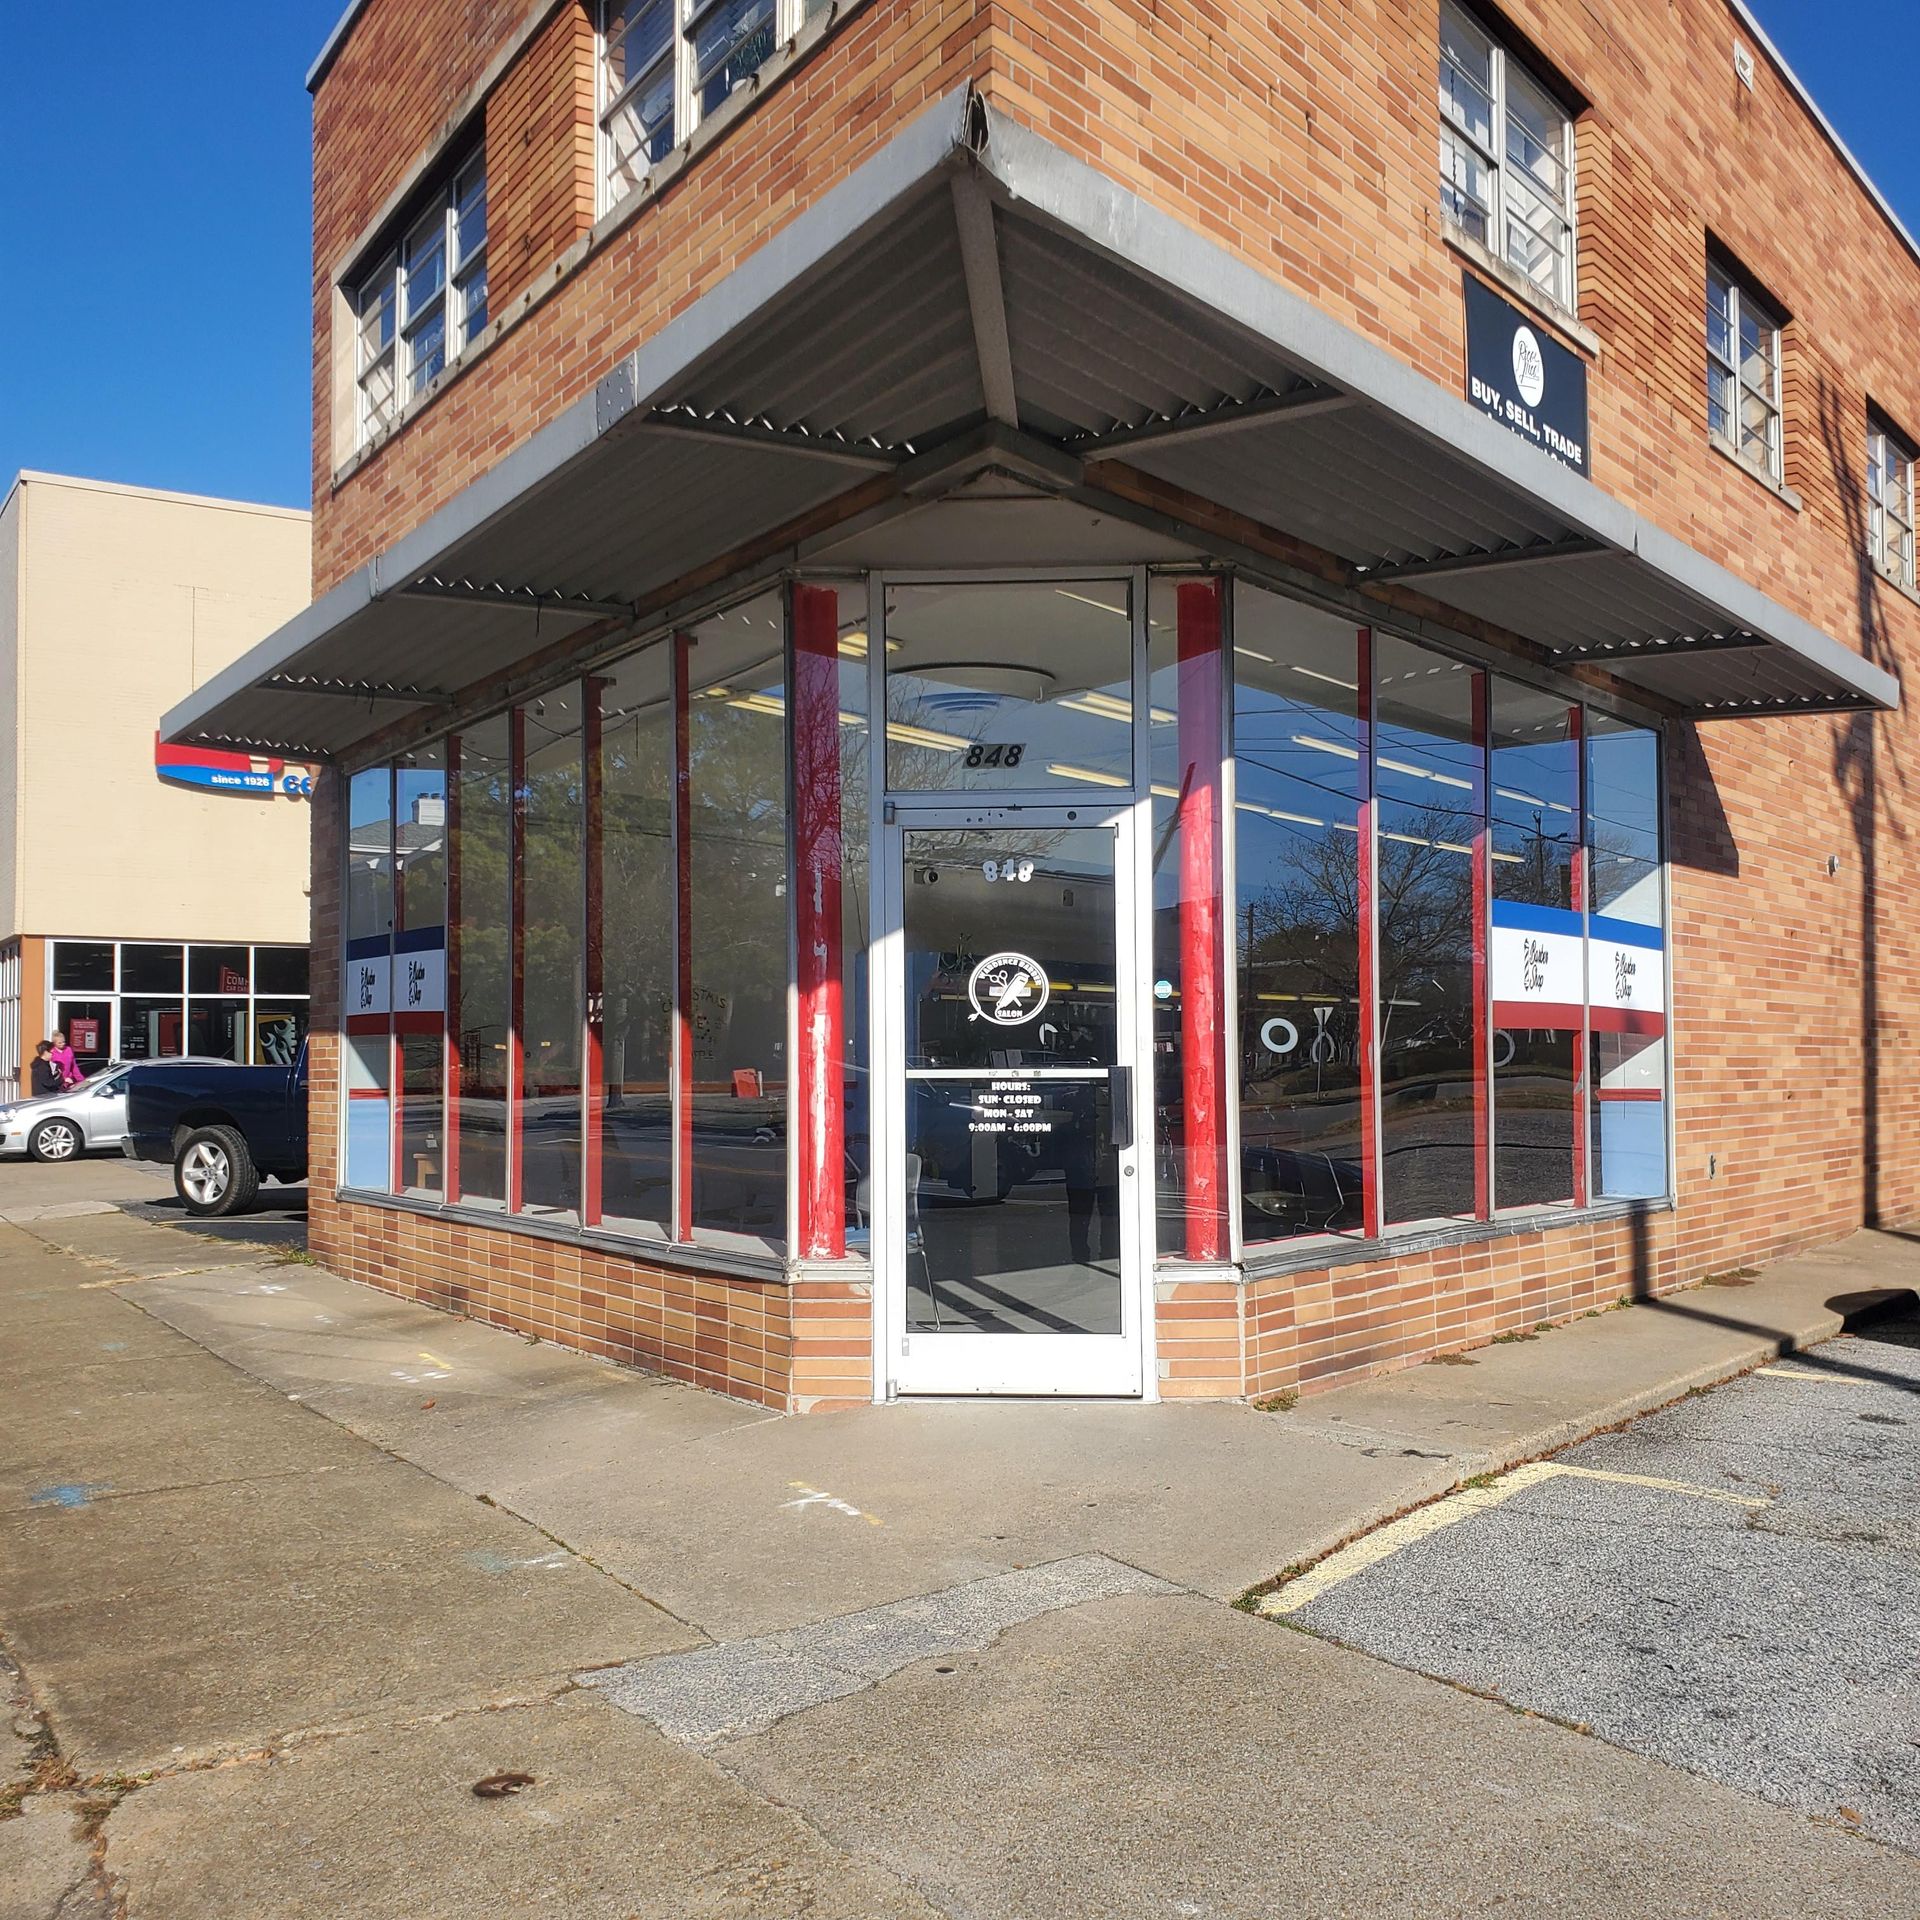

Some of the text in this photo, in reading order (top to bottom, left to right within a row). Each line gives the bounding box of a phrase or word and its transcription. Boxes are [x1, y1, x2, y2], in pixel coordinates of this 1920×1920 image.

[1471, 375, 1503, 417] BUY,
[1505, 399, 1541, 441] SELL,
[1542, 423, 1582, 465] TRADE
[966, 744, 1022, 768] 848
[211, 773, 270, 787] since 1926
[982, 858, 1034, 883] 848
[997, 1009, 1023, 1018] SALON
[991, 1081, 1031, 1091] HOURS:
[1003, 1095, 1042, 1104] CLOSED
[983, 1108, 1007, 1118] MON
[1014, 1108, 1034, 1118] SAT
[968, 1122, 1006, 1132] 9:00AM
[1013, 1123, 1052, 1132] 6:00PM
